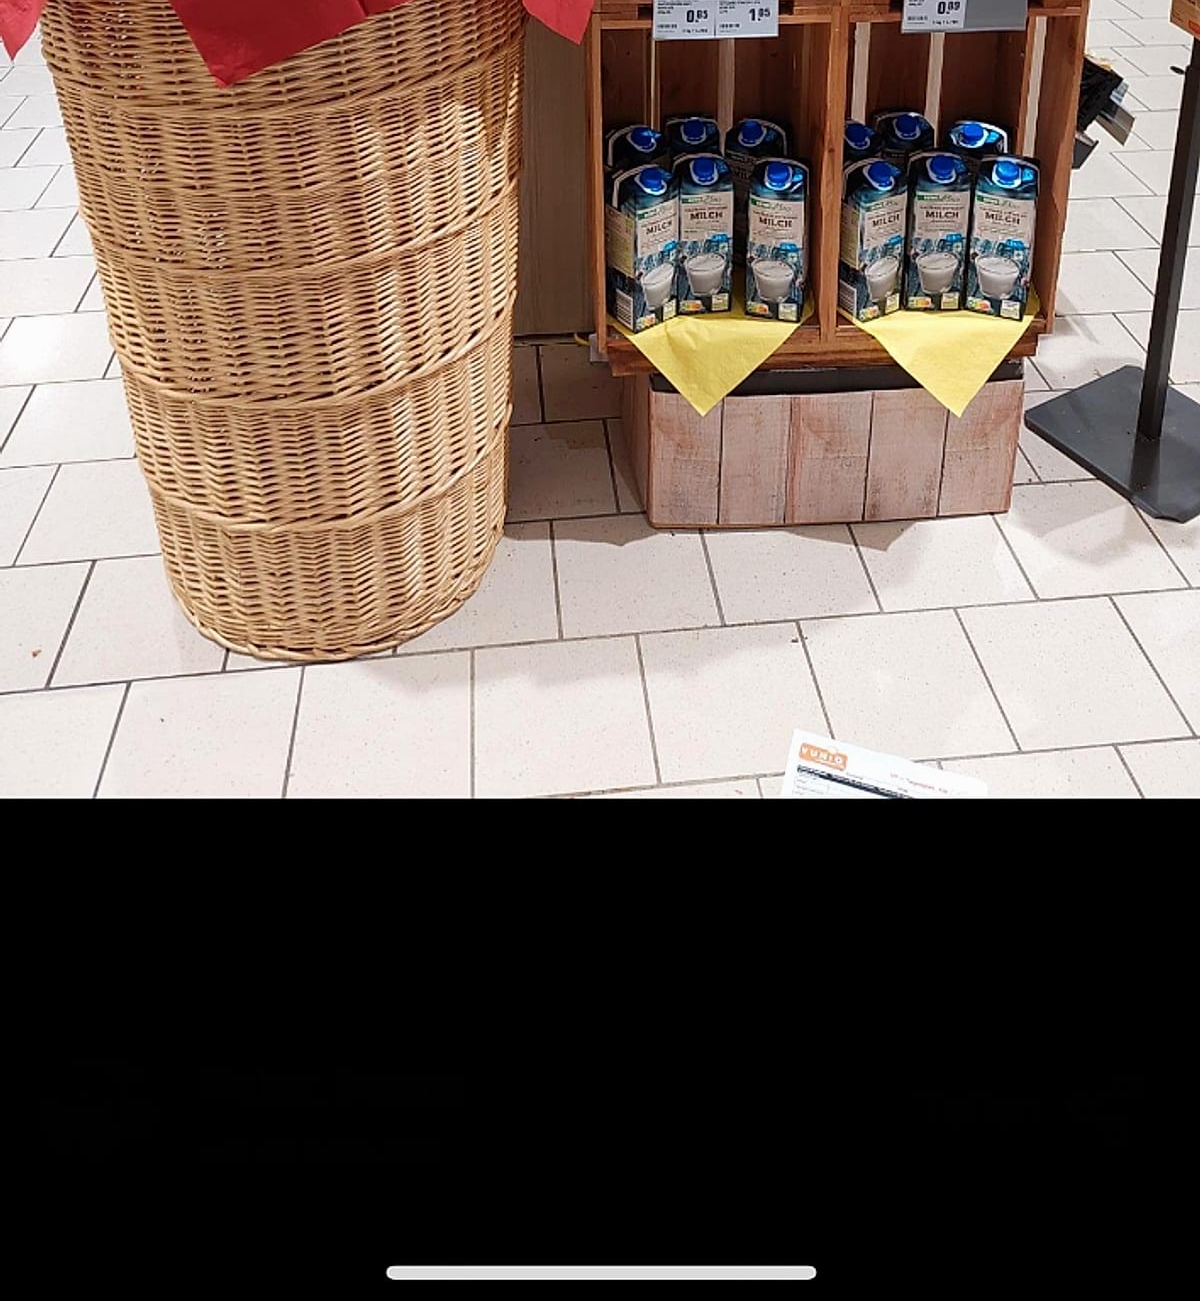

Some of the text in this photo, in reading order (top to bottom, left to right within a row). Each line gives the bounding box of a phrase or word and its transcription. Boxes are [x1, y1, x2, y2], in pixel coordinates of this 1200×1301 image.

[690, 211, 723, 221] MILCH
[872, 213, 900, 227] MILCH
[925, 210, 959, 219] MILCH
[984, 212, 1020, 226] MILCH
[645, 220, 673, 235] MILCH
[758, 215, 793, 228] MILCH
